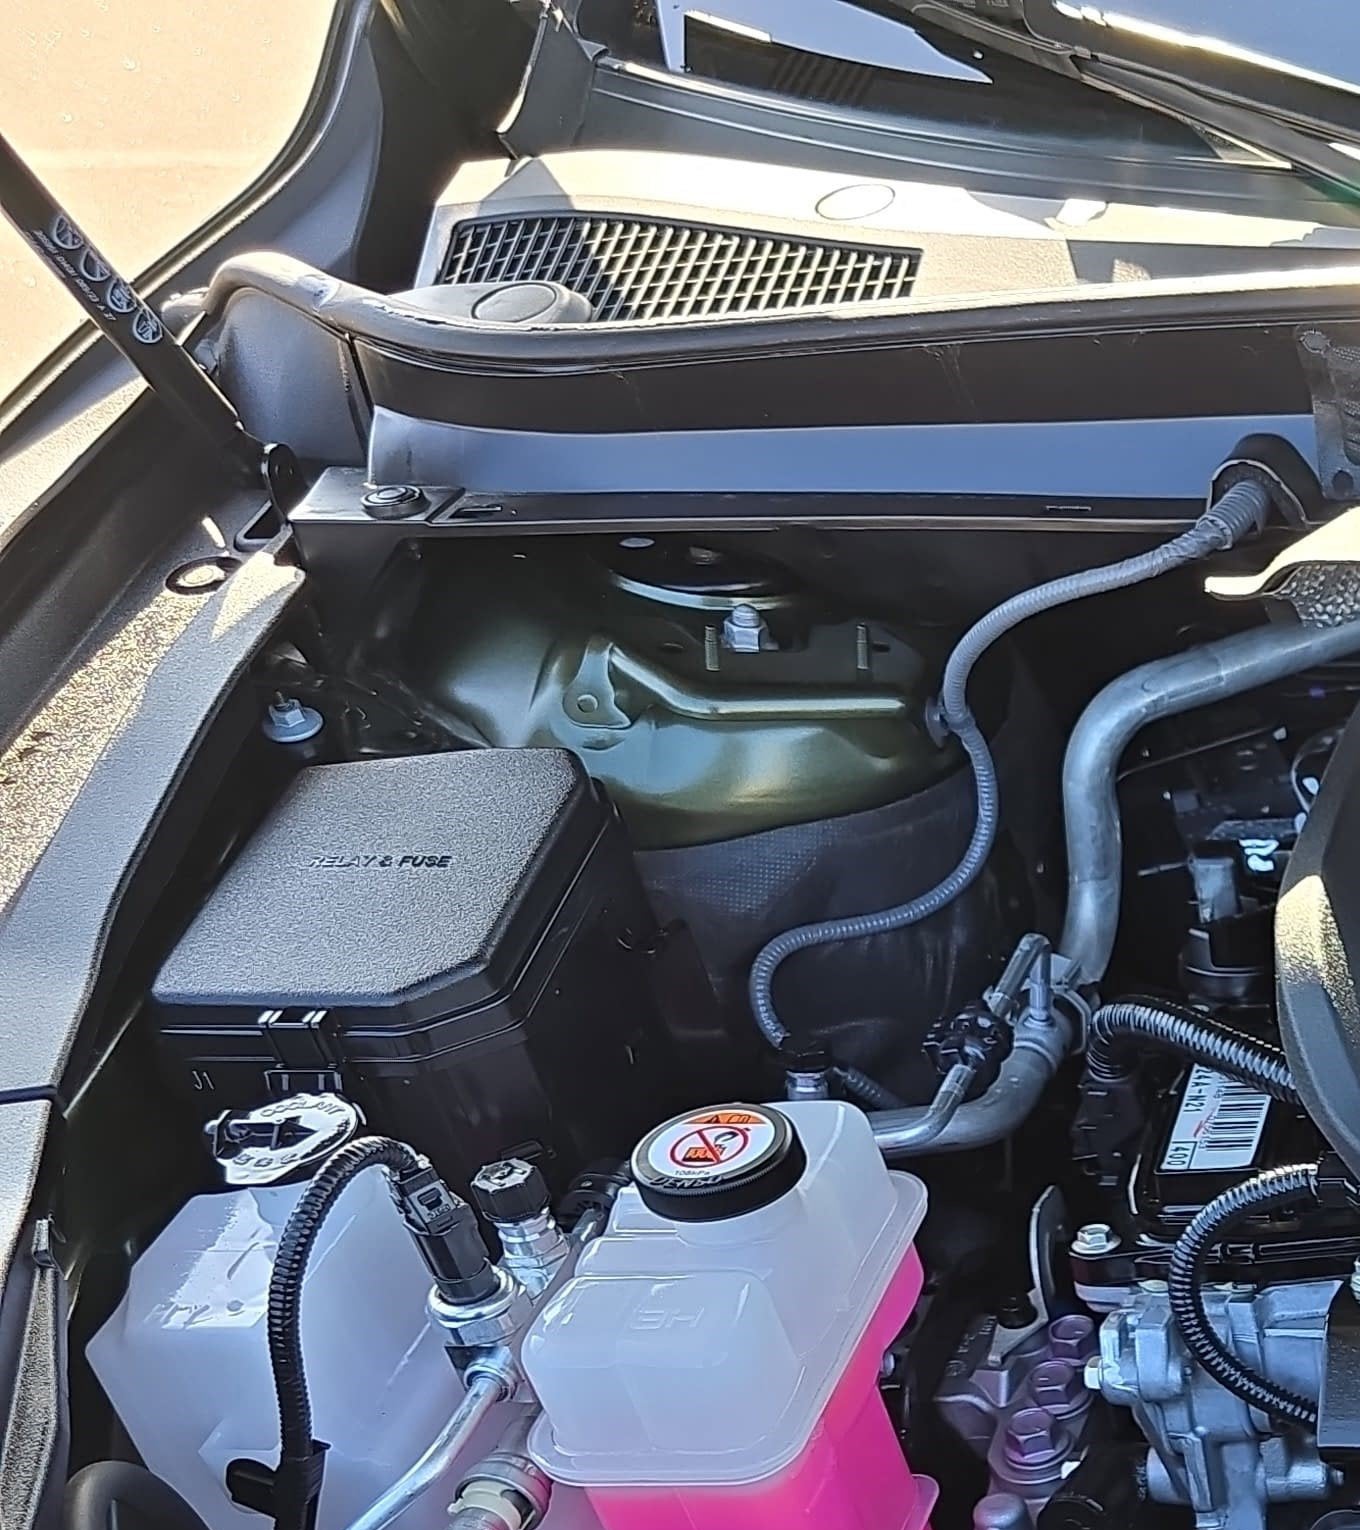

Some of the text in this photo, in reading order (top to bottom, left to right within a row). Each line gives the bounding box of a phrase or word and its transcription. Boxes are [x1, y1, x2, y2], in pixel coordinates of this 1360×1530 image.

[310, 856, 453, 868] RELAY & FUSE
[260, 1101, 346, 1118] COOLANT
[1166, 1146, 1190, 1166] 400
[649, 1175, 728, 1189] DENSO
